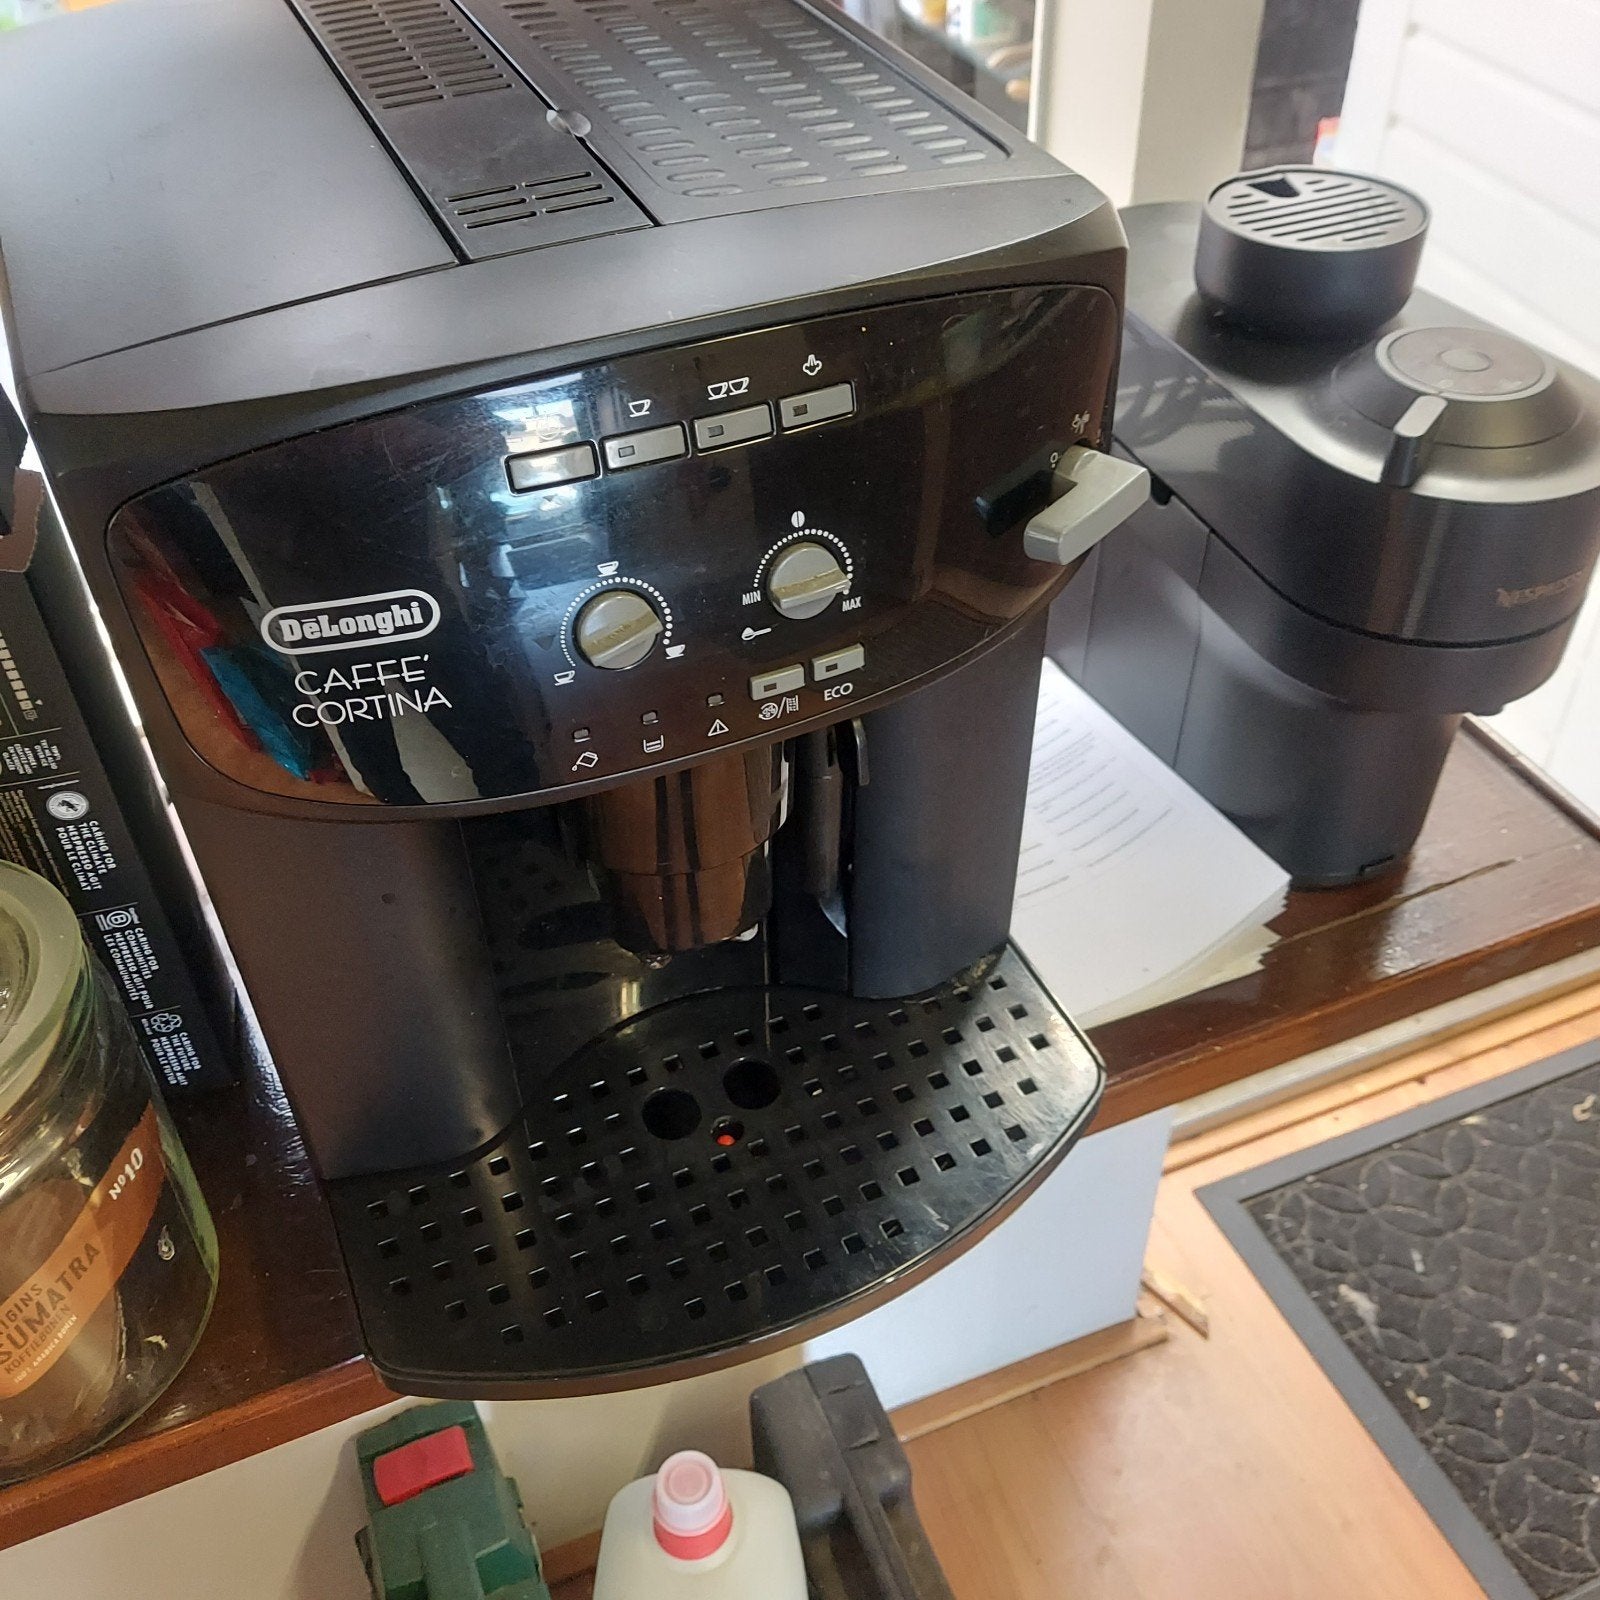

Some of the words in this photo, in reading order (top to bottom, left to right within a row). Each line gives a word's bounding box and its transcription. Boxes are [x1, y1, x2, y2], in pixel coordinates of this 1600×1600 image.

[742, 590, 762, 606] MIN
[842, 597, 862, 612] MAX
[292, 686, 453, 728] CORTINA
[824, 683, 853, 702] ECO
[55, 827, 73, 849] POUR
[66, 851, 78, 860] LE
[78, 822, 92, 838] THE
[86, 840, 107, 873] CLIMATE
[89, 821, 109, 851] CARING
[102, 853, 116, 868] FOR
[66, 825, 93, 869] NESPRESSO
[87, 872, 102, 889] AGIT
[71, 862, 91, 890] CLIMAT
[103, 934, 116, 946] LES
[124, 930, 152, 978] COMMUNITIES
[135, 927, 153, 954] CARING
[146, 956, 159, 970] FOR
[113, 932, 137, 971] NESPRESSO
[138, 990, 154, 1009] POUR
[150, 1038, 165, 1056] POUR
[160, 1036, 181, 1071] NESPRESSO
[170, 1034, 182, 1046] THE
[176, 1047, 192, 1070] FUTURE
[179, 1032, 196, 1056] CARING
[190, 1057, 201, 1069] FOR
[4, 1303, 71, 1374] KOFFIEBONEN
